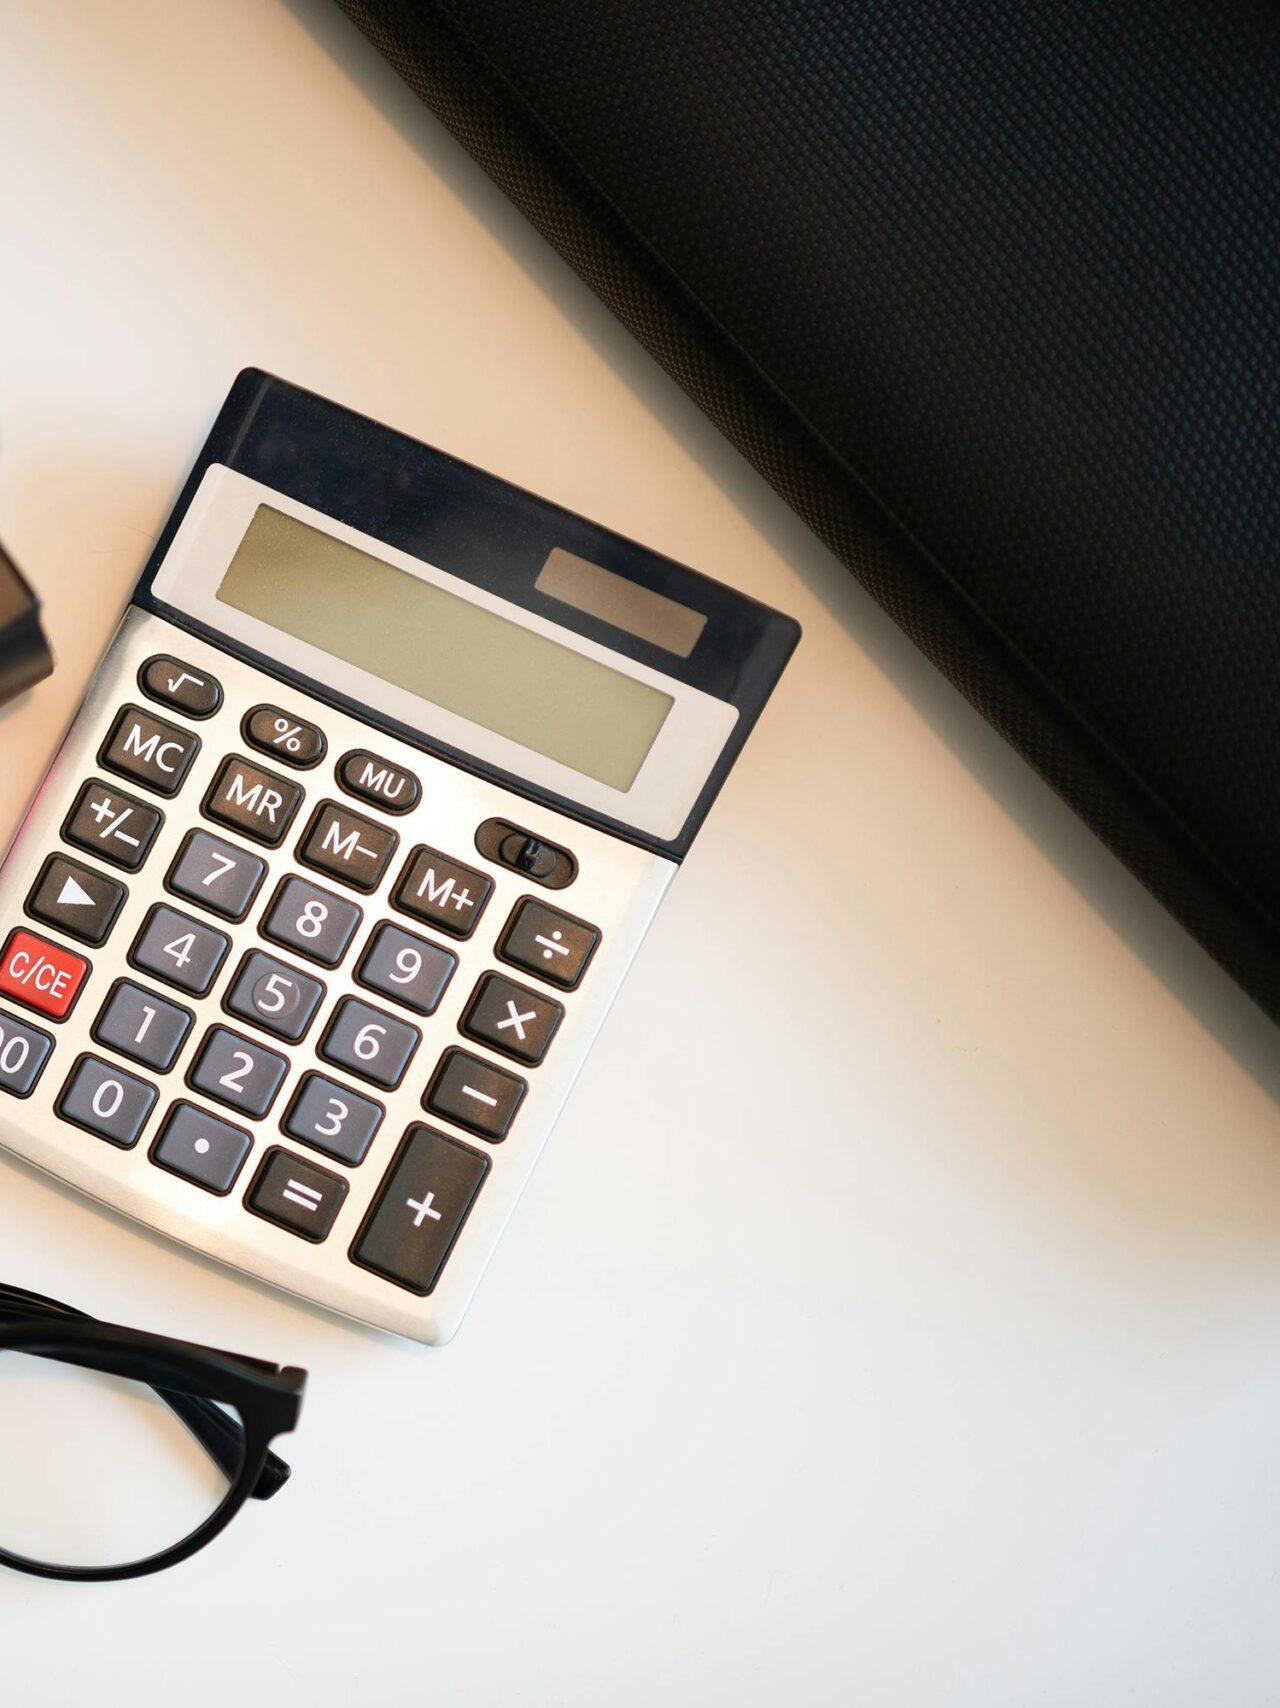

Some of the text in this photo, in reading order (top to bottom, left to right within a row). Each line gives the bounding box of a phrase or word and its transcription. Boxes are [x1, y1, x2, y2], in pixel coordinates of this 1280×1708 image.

[122, 723, 185, 773] MC
[272, 718, 303, 752] %
[225, 773, 283, 823] MR
[358, 762, 406, 798] MU
[201, 851, 237, 887] 7
[416, 868, 474, 911] M+
[295, 900, 329, 939] 8
[162, 932, 197, 968] 4
[387, 947, 423, 985] 9
[8, 950, 73, 1000] C/CE
[257, 973, 294, 1013] 5
[134, 1005, 157, 1044] 1
[353, 1023, 388, 1061] 6
[218, 1050, 255, 1094] 2
[92, 1079, 125, 1118] 0
[314, 1097, 349, 1136] 3
